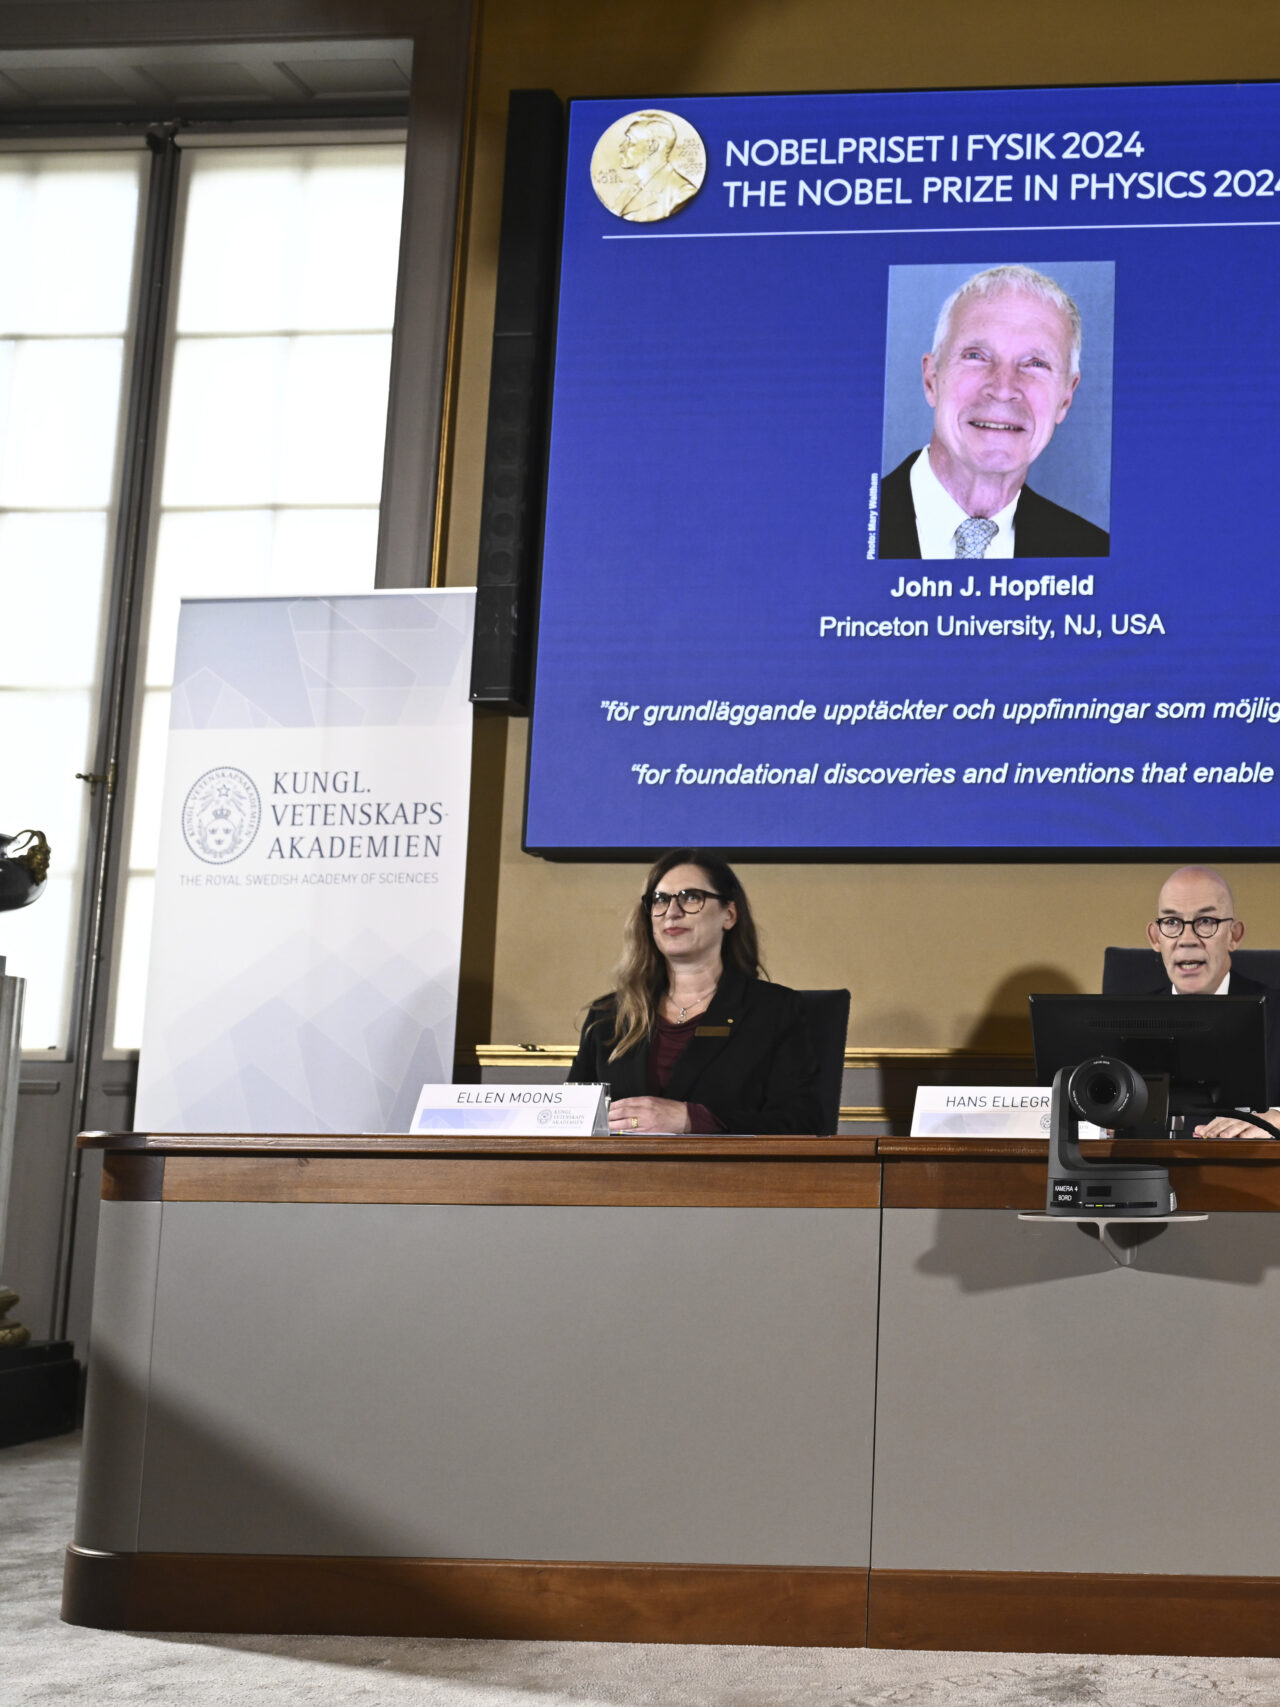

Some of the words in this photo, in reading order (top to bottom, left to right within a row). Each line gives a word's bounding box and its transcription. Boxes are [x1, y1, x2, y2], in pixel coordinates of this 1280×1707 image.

[725, 135, 945, 167] NOBELPRISET
[951, 134, 958, 162] I
[967, 132, 1056, 162] FYSIK
[1062, 130, 1145, 160] 2024
[722, 179, 787, 208] THE
[797, 177, 913, 207] NOBEL
[922, 174, 1014, 204] PRIZE
[1024, 174, 1058, 202] IN
[1070, 170, 1207, 201] PHYSICS
[890, 576, 953, 598] John
[959, 575, 982, 597] J.
[989, 574, 1094, 602] Hopfield
[819, 615, 929, 638] Princeton
[936, 614, 1055, 641] University,
[1064, 613, 1102, 639] NJ,
[1111, 613, 1166, 635] USA
[642, 701, 817, 727] grundläggande
[823, 698, 949, 726] upptäckter
[952, 698, 996, 720] och
[1002, 697, 1152, 725] uppfinningar
[1155, 702, 1206, 719] som
[273, 770, 371, 795] KUNGL.
[674, 763, 818, 785] foundational
[823, 762, 957, 785] discoveries
[962, 762, 1009, 784] and
[1013, 762, 1135, 784] inventions
[1141, 761, 1188, 784] that
[1192, 761, 1275, 784] enable
[267, 834, 442, 859] AKADEMIEN
[180, 874, 202, 886] THE
[204, 874, 242, 886] ROYAL
[245, 873, 299, 886] SWEDISH
[301, 872, 358, 885] ACADEMY
[360, 872, 376, 885] OF
[378, 871, 440, 885] SCIENCES
[456, 1092, 505, 1104] ELLEN
[509, 1092, 563, 1104] MOONS
[946, 1095, 987, 1108] HANS
[992, 1096, 1050, 1108] ELLEGR
